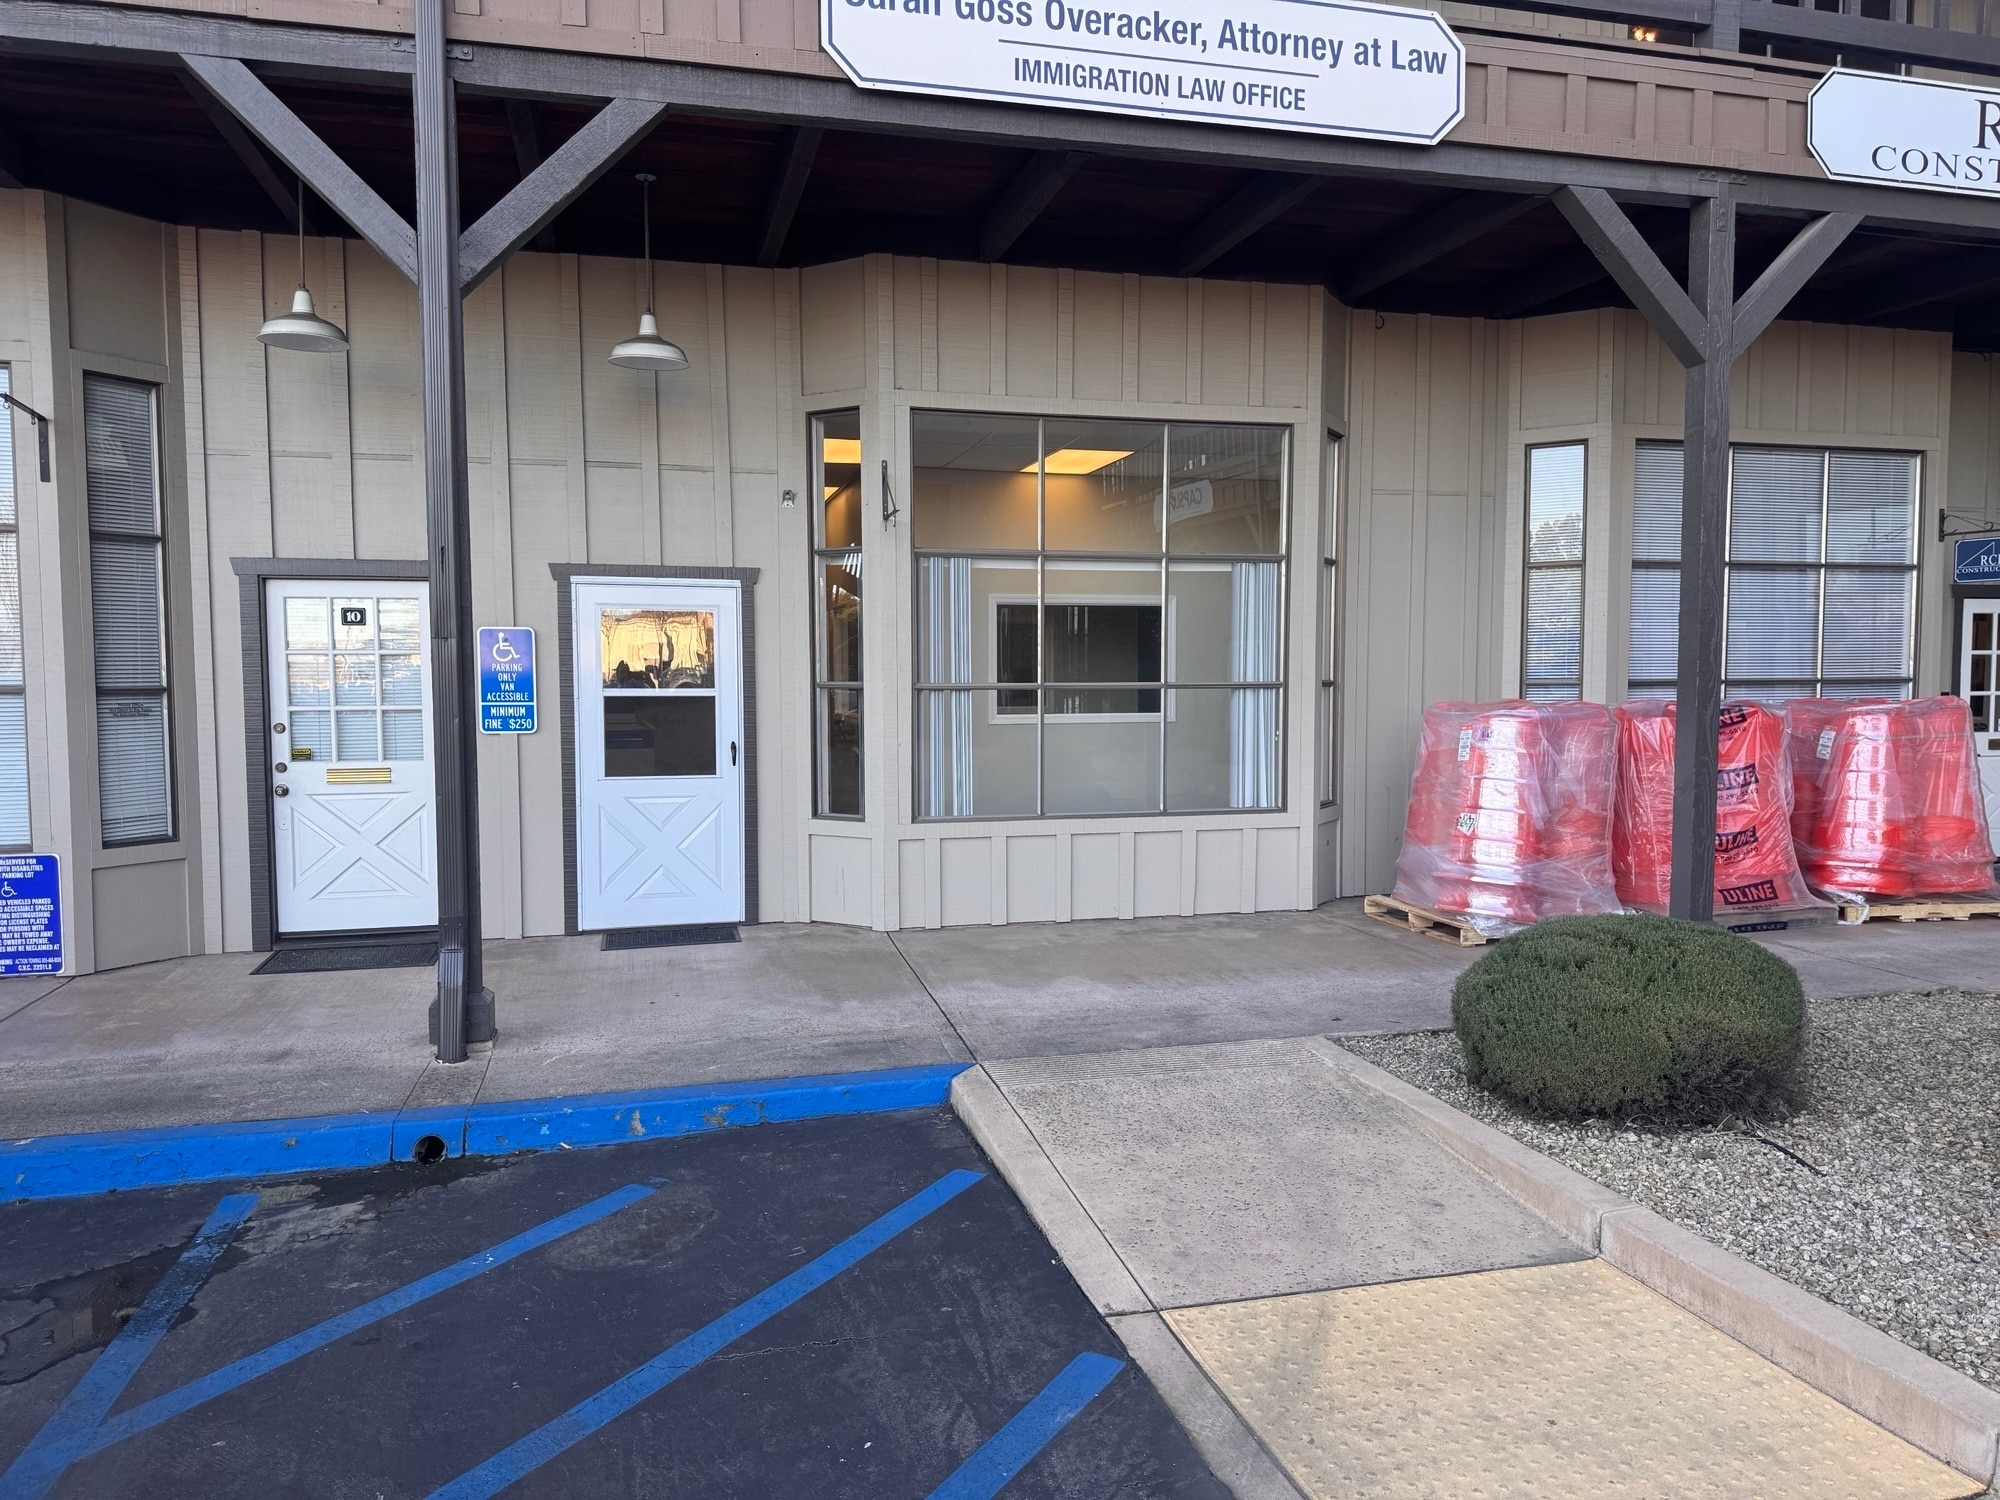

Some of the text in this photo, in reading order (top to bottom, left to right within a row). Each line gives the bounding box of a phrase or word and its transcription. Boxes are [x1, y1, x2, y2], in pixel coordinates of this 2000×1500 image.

[955, 0, 1033, 27] Goss
[1045, 0, 1207, 53] Overacker,
[1217, 18, 1344, 69] Attorney
[1353, 38, 1382, 67] at
[1391, 39, 1448, 75] Law
[1014, 57, 1306, 111] IMMIGRATION LAW OFFICE
[346, 610, 361, 622] 10
[491, 663, 523, 672] PARKING
[497, 673, 517, 682] ONLY
[500, 682, 515, 691] VAN
[486, 692, 529, 701] ACCESSIBLE
[490, 706, 526, 717] MINIMUM
[484, 718, 532, 730] FINE $250
[1723, 883, 1775, 903] ULINE
[6, 898, 31, 906] VEHICLES
[31, 897, 52, 905] PARKED
[11, 911, 51, 919] DISTINGUISHING
[8, 918, 30, 926] LICENSE
[30, 917, 49, 925] PLATES
[31, 924, 45, 932] WITH
[40, 930, 54, 938] AWAY
[3, 938, 26, 946] OWNER'S
[26, 937, 50, 945] EXPENSE.
